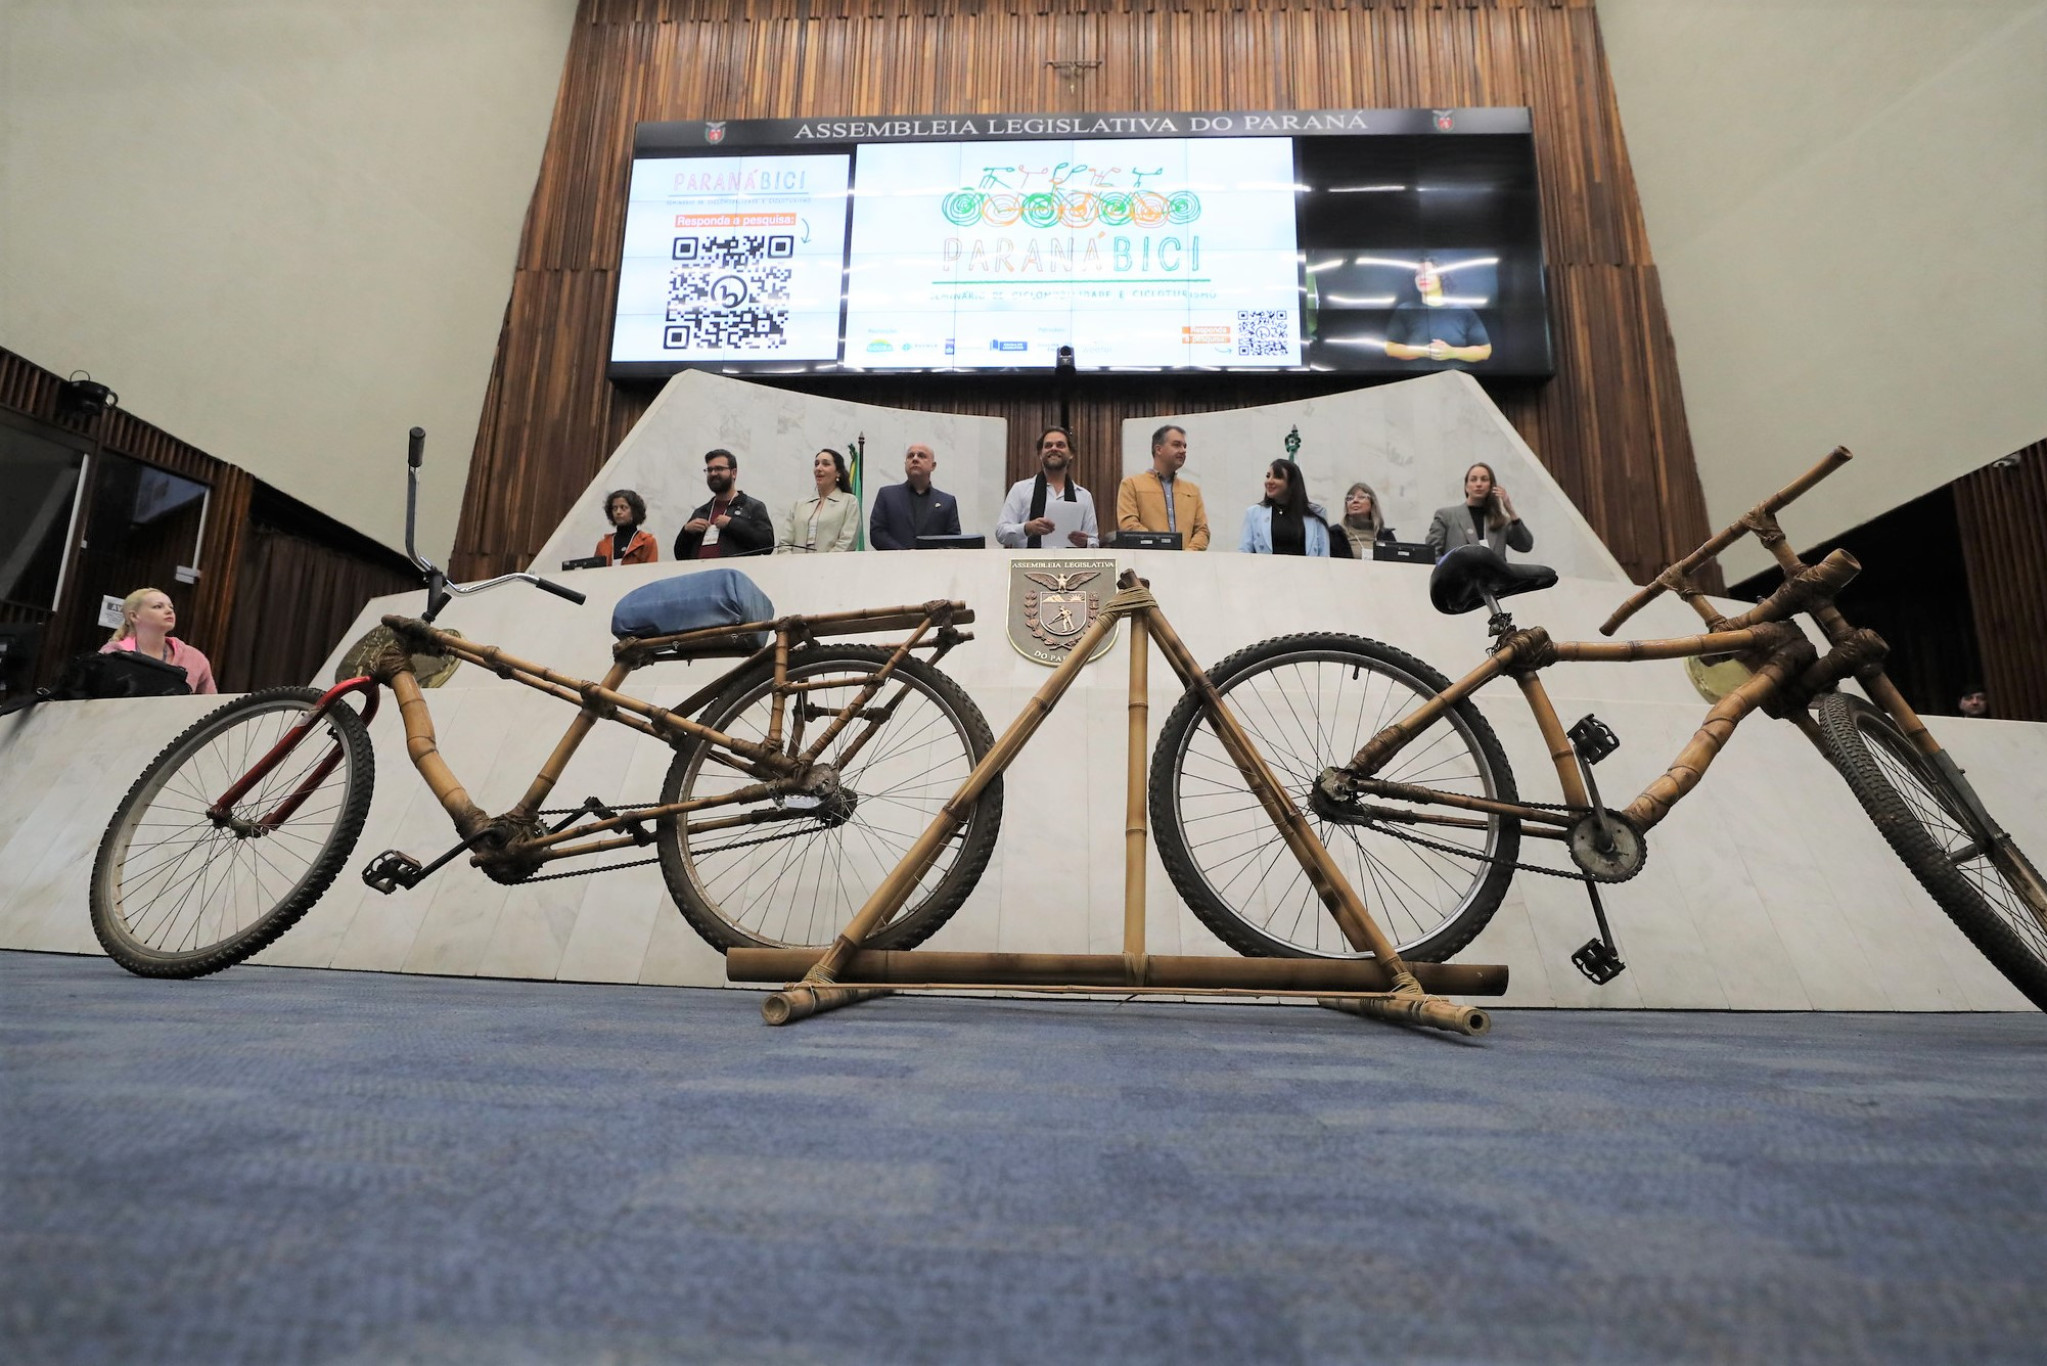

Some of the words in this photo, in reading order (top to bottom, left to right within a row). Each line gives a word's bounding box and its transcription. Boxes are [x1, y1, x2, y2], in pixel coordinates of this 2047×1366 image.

[794, 120, 979, 139] ASSEMBLEIA
[987, 117, 1178, 135] LEGISLATIVA
[1190, 116, 1233, 132] DO
[1244, 110, 1368, 131] PARANÁ
[677, 214, 731, 226] Responda
[1034, 650, 1048, 659] DO
